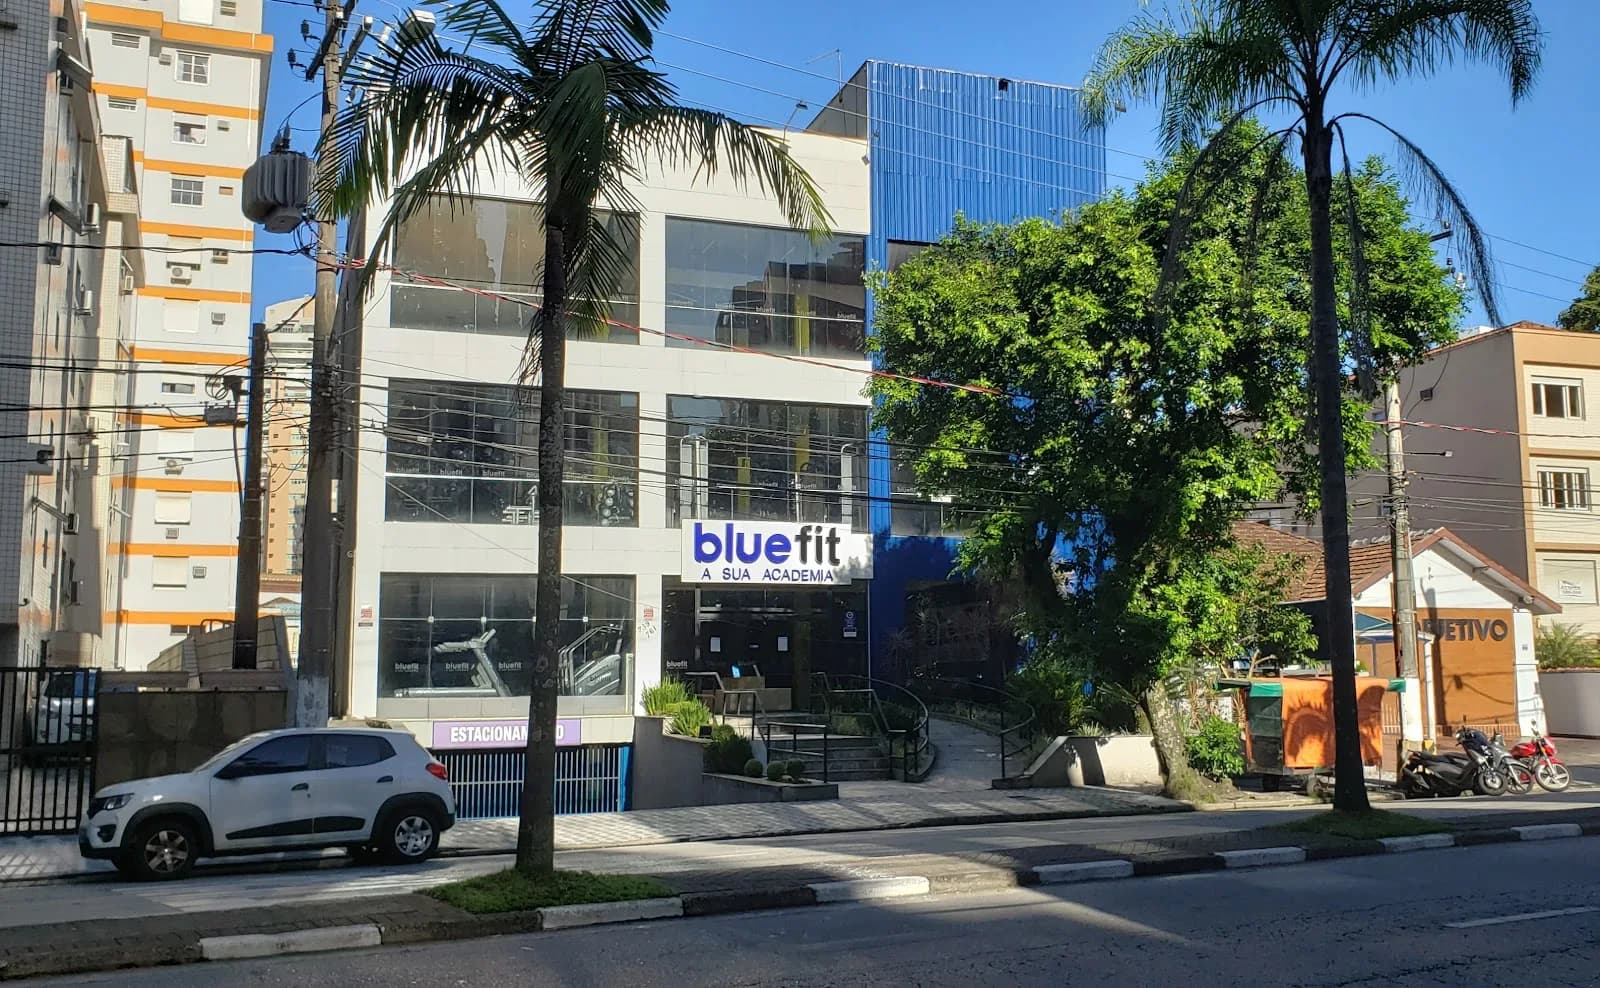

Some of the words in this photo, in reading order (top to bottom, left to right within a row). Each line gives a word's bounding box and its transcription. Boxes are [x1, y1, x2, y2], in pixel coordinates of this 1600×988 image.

[701, 569, 711, 580] A
[722, 568, 751, 581] SUA
[762, 569, 834, 582] ACADEMIA
